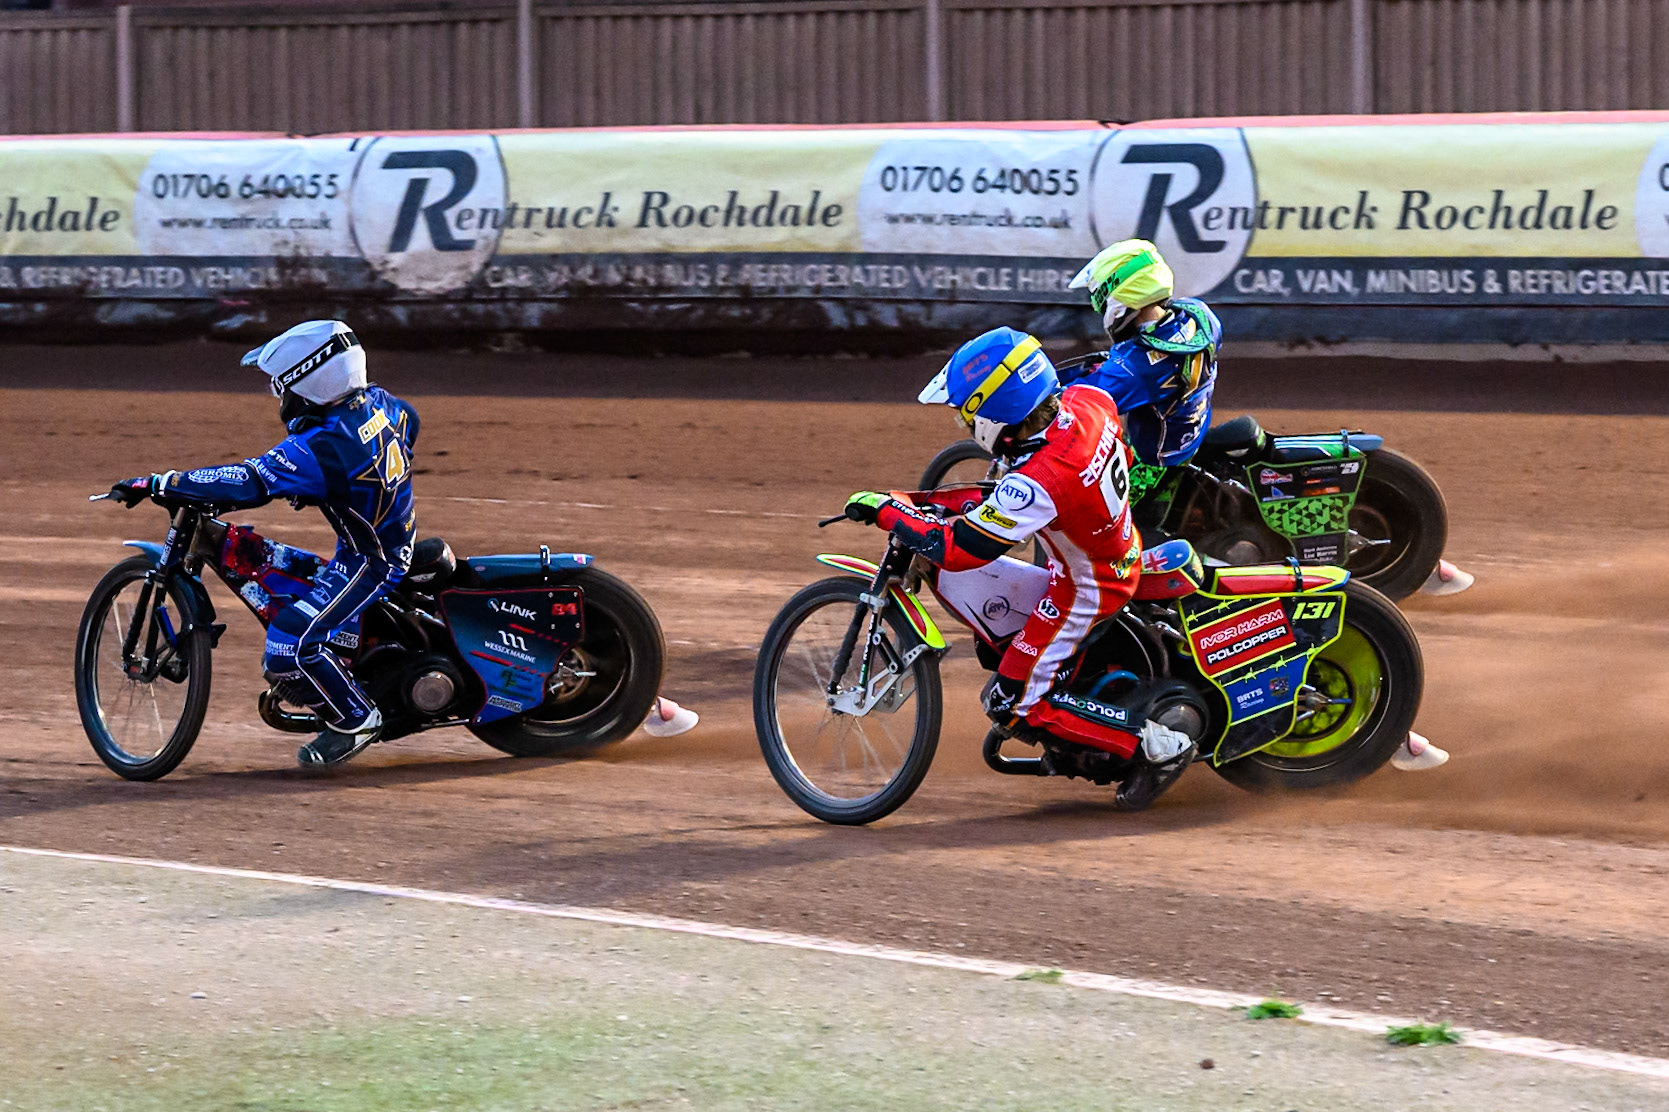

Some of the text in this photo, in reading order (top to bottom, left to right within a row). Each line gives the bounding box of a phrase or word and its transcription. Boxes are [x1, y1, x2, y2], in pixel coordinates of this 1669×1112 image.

[153, 173, 339, 199] 01706 640055
[880, 165, 1079, 196] 01706 640055
[0, 196, 121, 232] hdale
[635, 190, 843, 229] Rochdale
[1394, 188, 1618, 231] Rochdale
[912, 266, 1012, 291] VEHICLE
[1016, 267, 1076, 293] HIRE
[1366, 269, 1476, 294] MINIBUS
[1482, 269, 1503, 294] &
[283, 342, 334, 385] SCOTT
[386, 438, 405, 483] 4
[1001, 485, 1027, 502] ATPI
[1110, 456, 1127, 500] 6
[501, 602, 537, 620] LINK
[1292, 602, 1336, 620] 131
[1200, 609, 1285, 650] IVOR HARM
[1207, 626, 1287, 664] POLCOPPER
[484, 641, 536, 664] WESSEX MARINE
